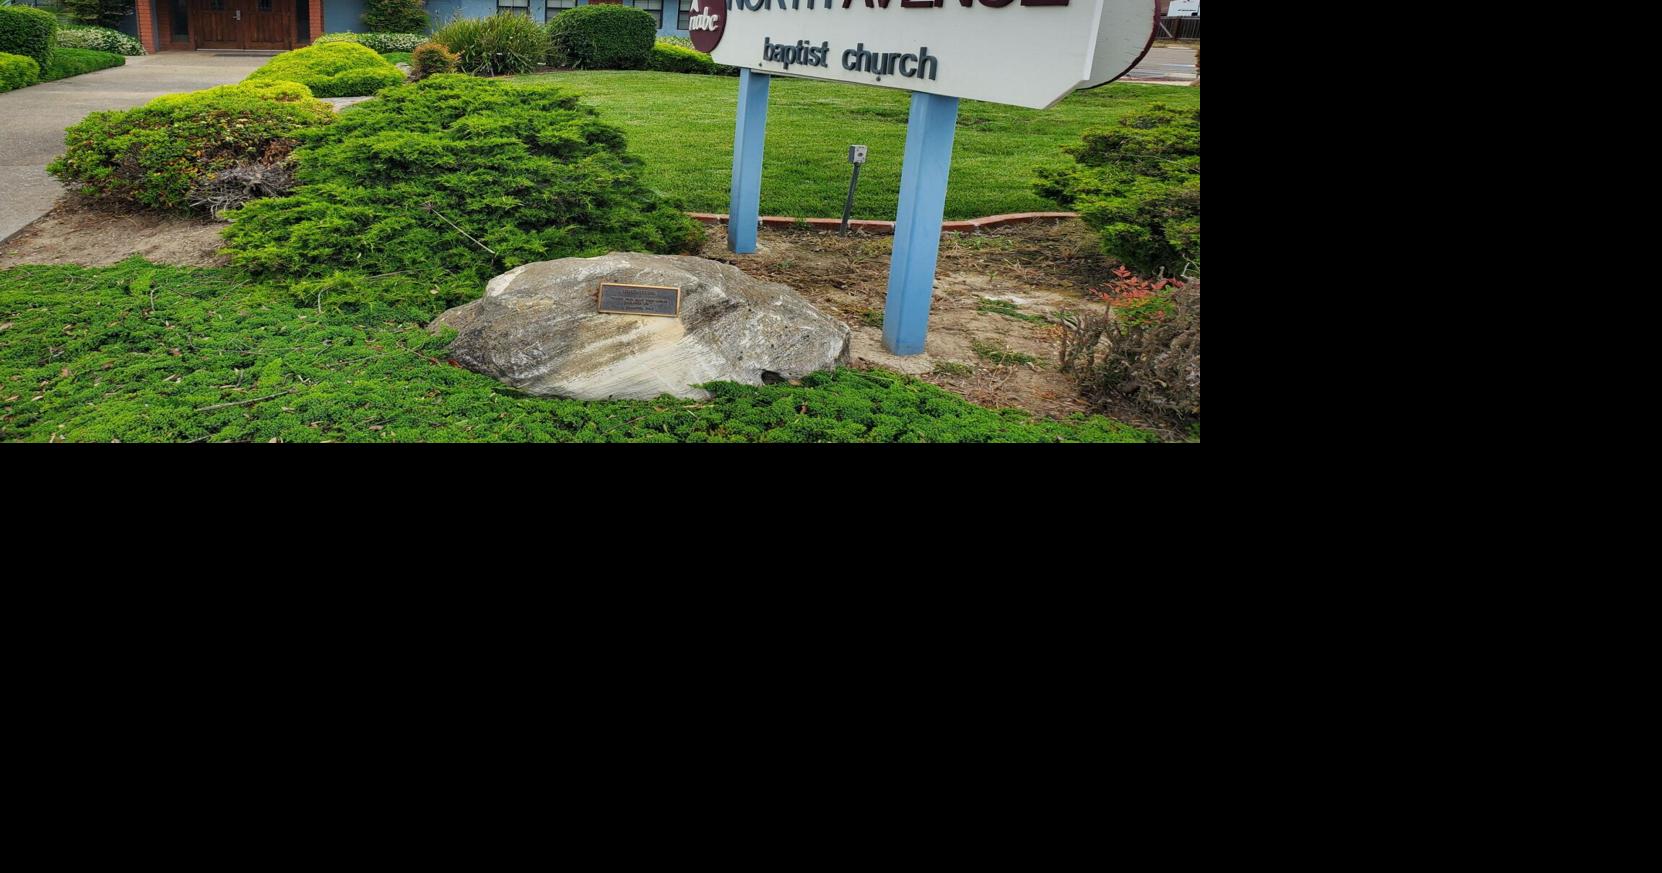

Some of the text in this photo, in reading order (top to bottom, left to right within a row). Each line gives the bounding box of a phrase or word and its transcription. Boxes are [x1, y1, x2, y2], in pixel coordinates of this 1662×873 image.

[688, 6, 719, 32] nabc
[762, 36, 938, 81] baptist church
